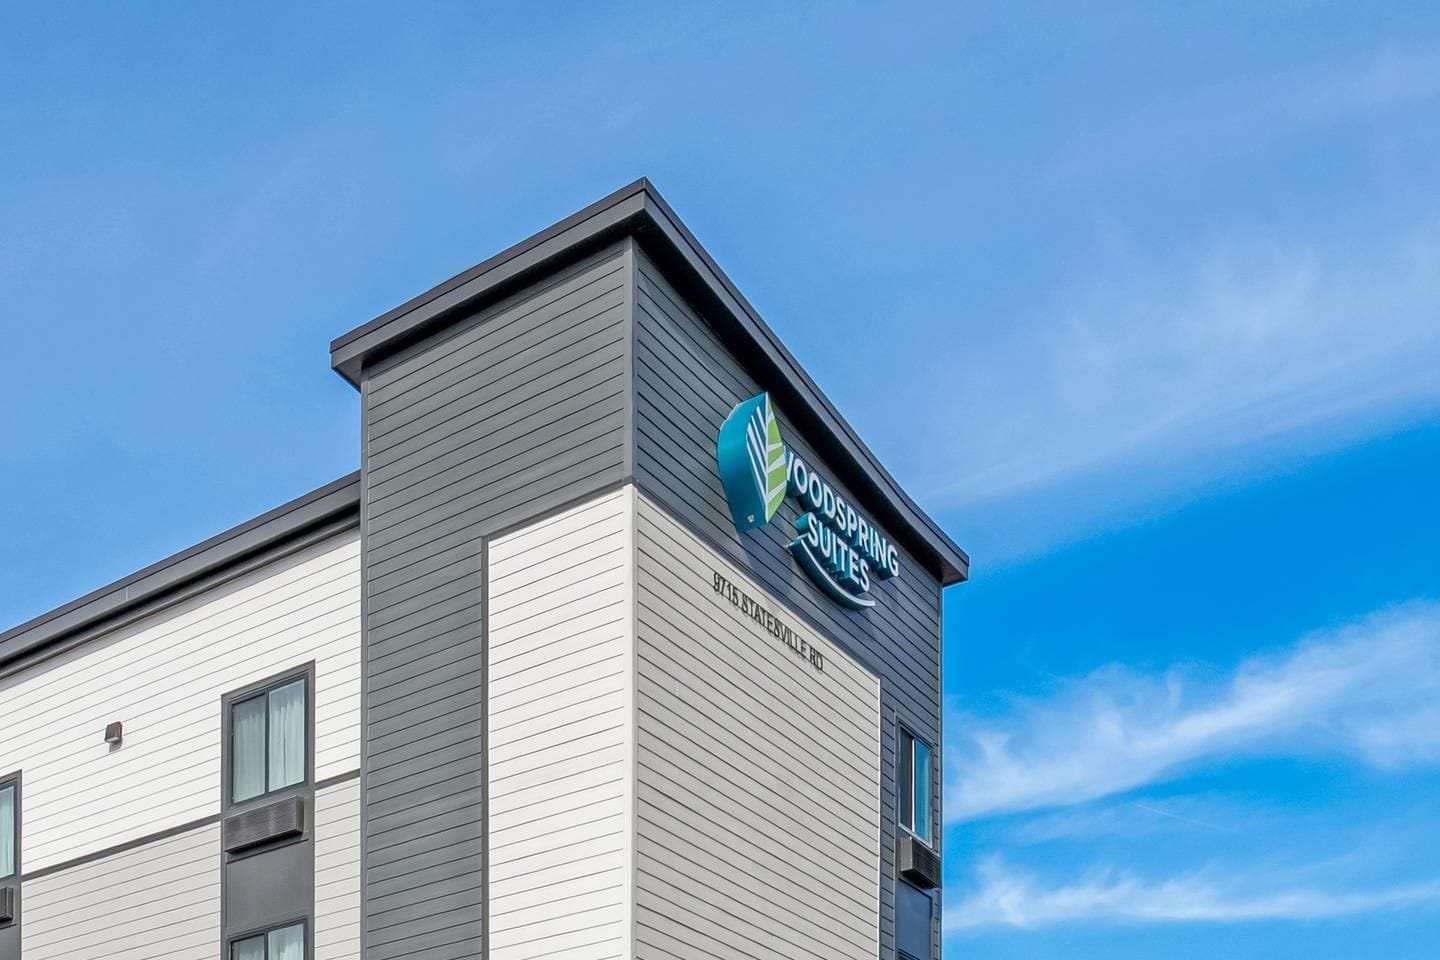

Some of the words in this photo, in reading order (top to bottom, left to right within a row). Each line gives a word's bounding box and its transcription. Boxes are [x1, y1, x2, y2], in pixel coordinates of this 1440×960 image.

[784, 446, 899, 578] OODSPRING
[807, 511, 870, 592] SUITES
[713, 571, 739, 606] 9715
[741, 592, 807, 660] STATESVILLE
[809, 645, 823, 671] RD
